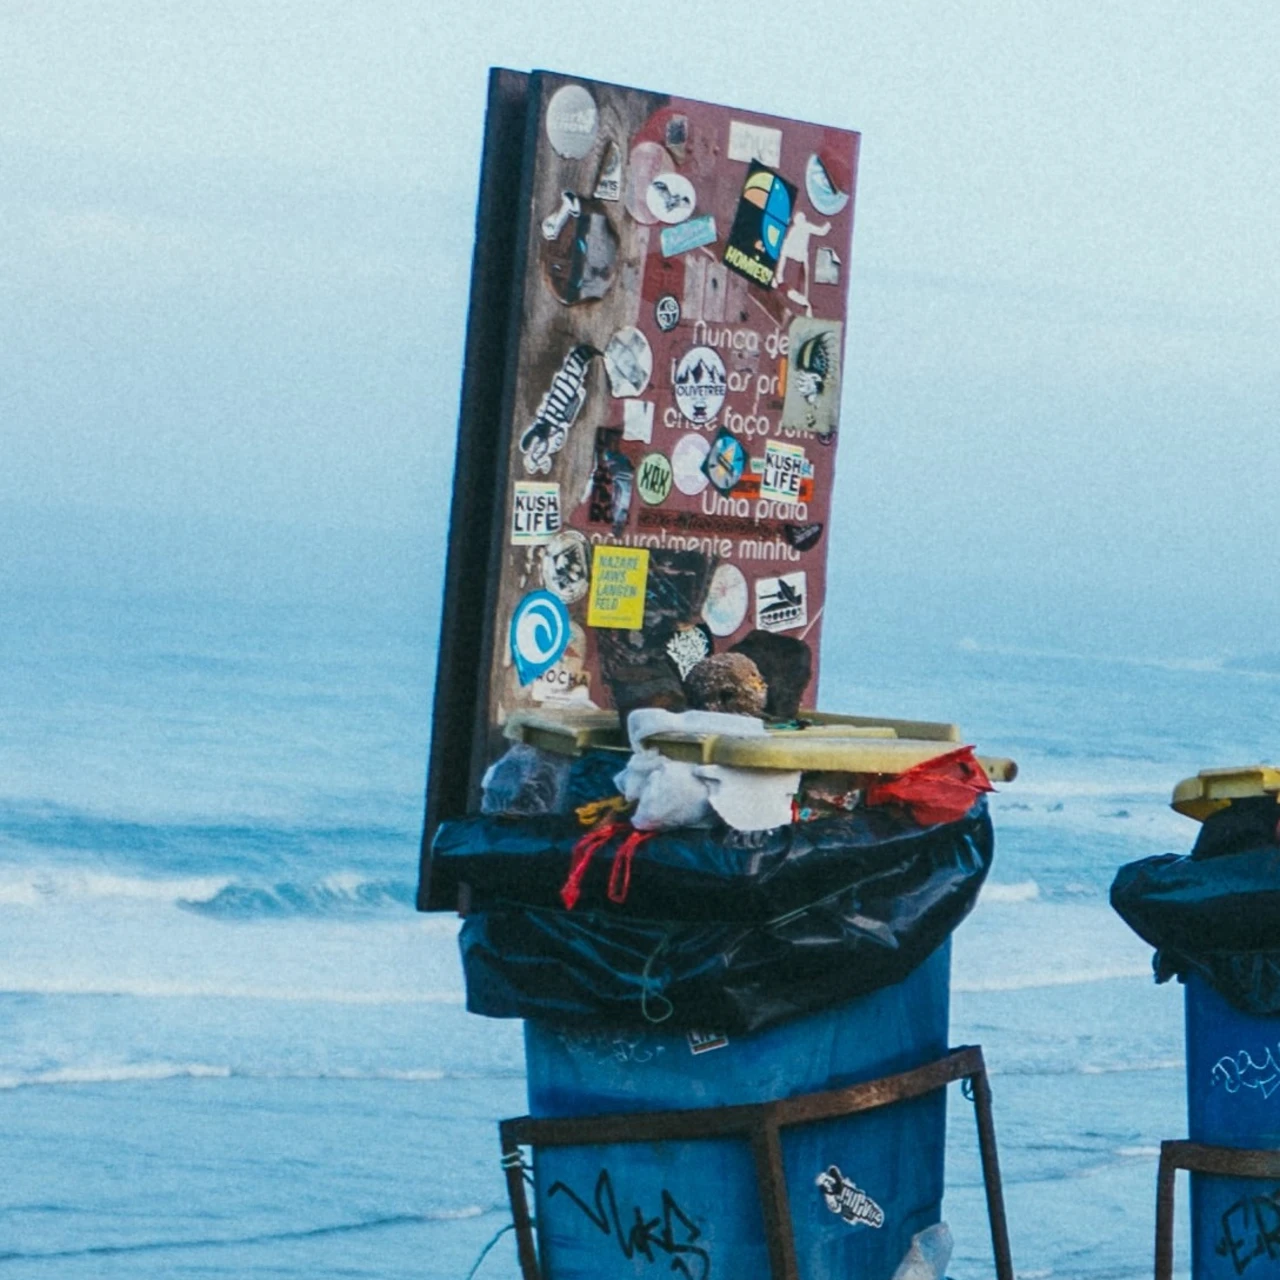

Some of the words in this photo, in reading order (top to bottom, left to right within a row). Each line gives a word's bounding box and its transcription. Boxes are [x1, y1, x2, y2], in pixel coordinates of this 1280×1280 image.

[765, 327, 789, 356] de
[727, 372, 753, 392] as
[724, 406, 770, 440] faço
[766, 453, 802, 473] KUSH
[763, 469, 800, 492] LIFE
[515, 495, 558, 512] KUSH
[702, 491, 750, 517] Uma
[755, 499, 808, 526] praia
[514, 512, 560, 532] LIFE
[590, 528, 733, 558] nauralmente
[739, 534, 801, 561] minha
